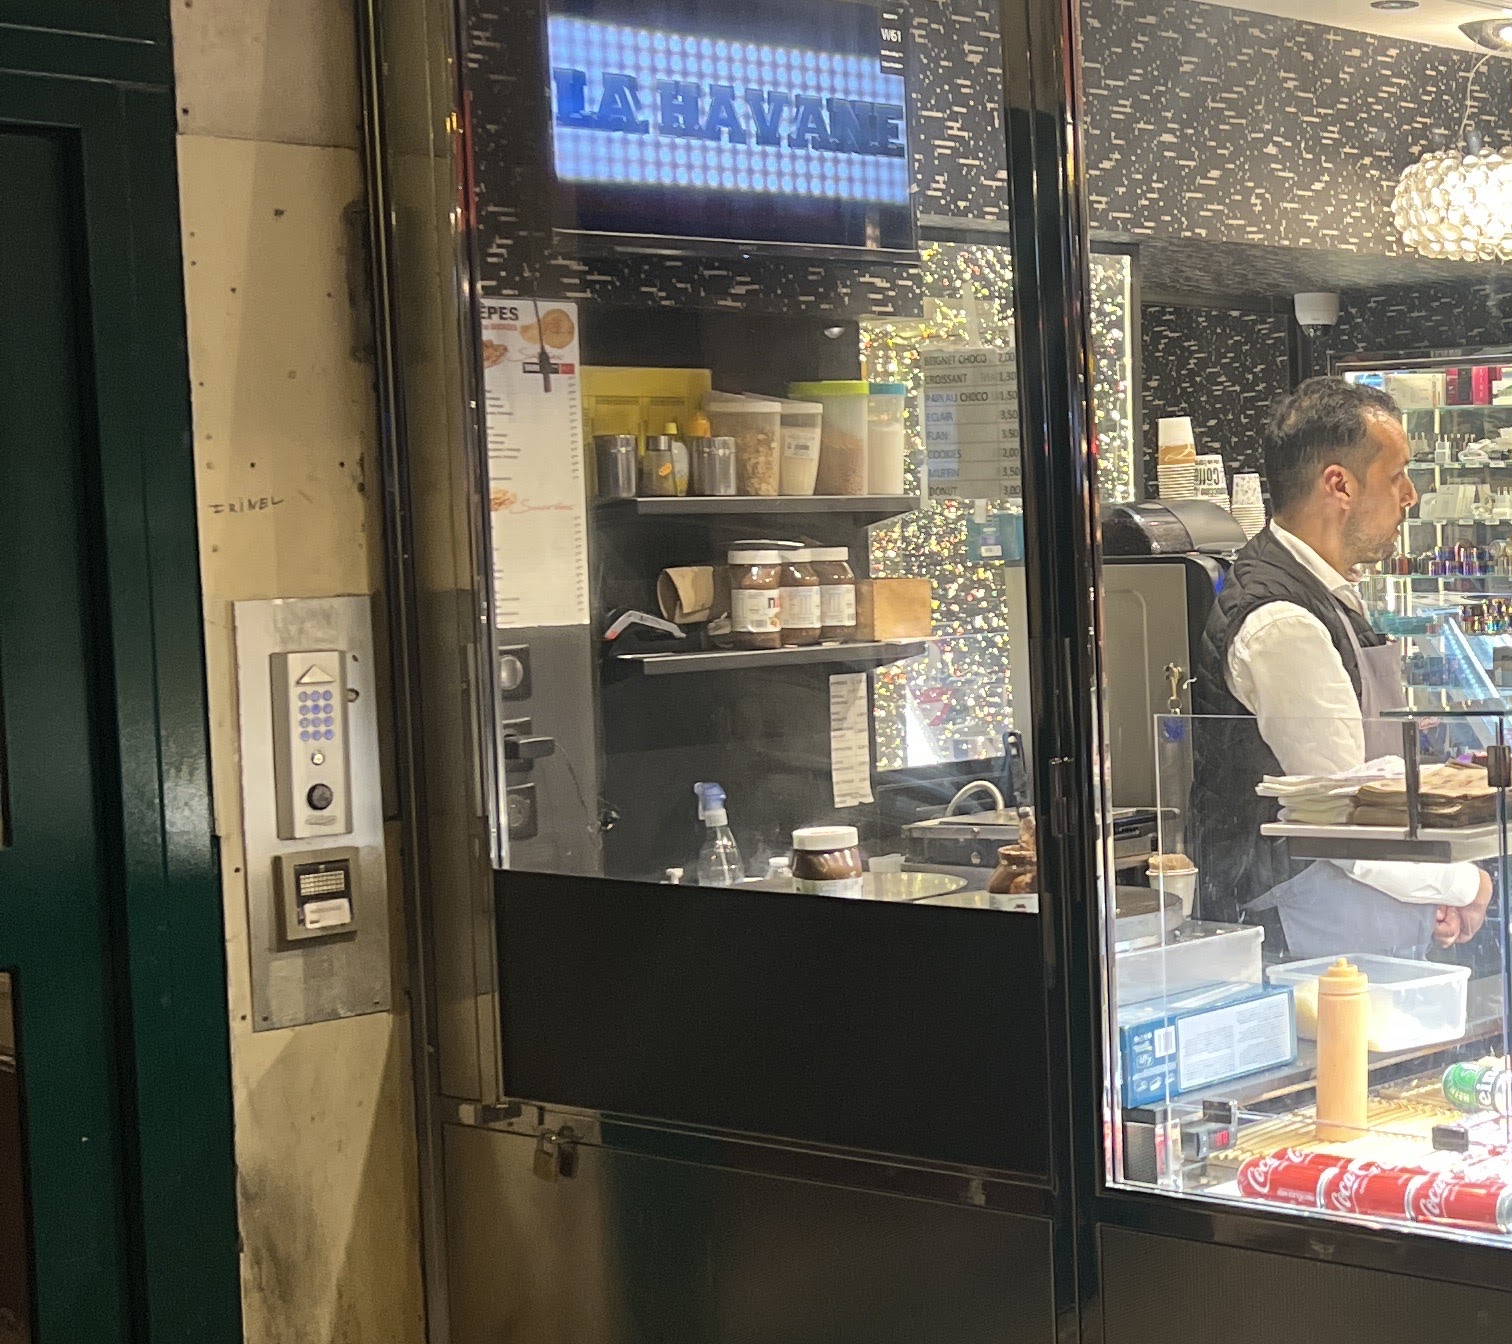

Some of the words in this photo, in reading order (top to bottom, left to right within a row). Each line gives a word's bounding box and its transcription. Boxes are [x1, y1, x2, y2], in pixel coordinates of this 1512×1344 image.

[553, 67, 650, 134] LA
[657, 78, 905, 158] HAVANE
[958, 354, 987, 364] CHOCO
[925, 374, 967, 384] CROISSANT
[960, 392, 988, 402] CHOCO
